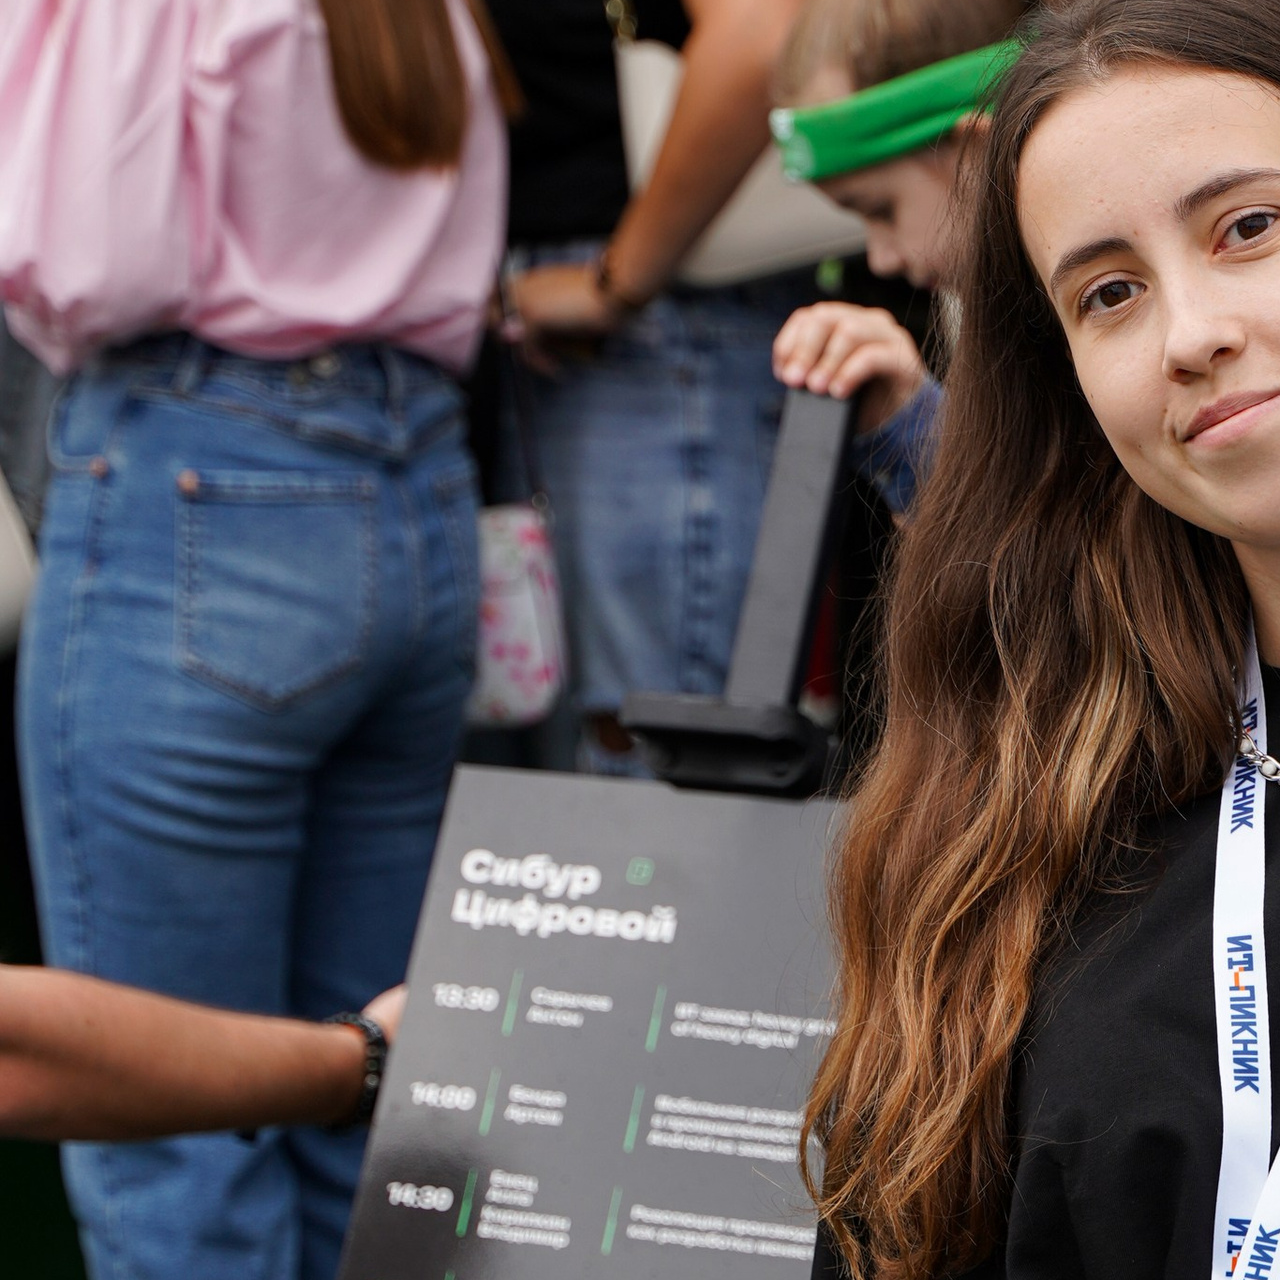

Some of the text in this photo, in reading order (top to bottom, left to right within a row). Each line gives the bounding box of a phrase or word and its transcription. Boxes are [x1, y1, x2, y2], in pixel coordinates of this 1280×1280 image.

[460, 848, 602, 900] Сибур
[452, 888, 678, 944] Цифровой
[1227, 934, 1260, 1094] ИТ-ПИКНИК
[410, 1081, 476, 1110] 14:00
[387, 1182, 454, 1211] 14:30
